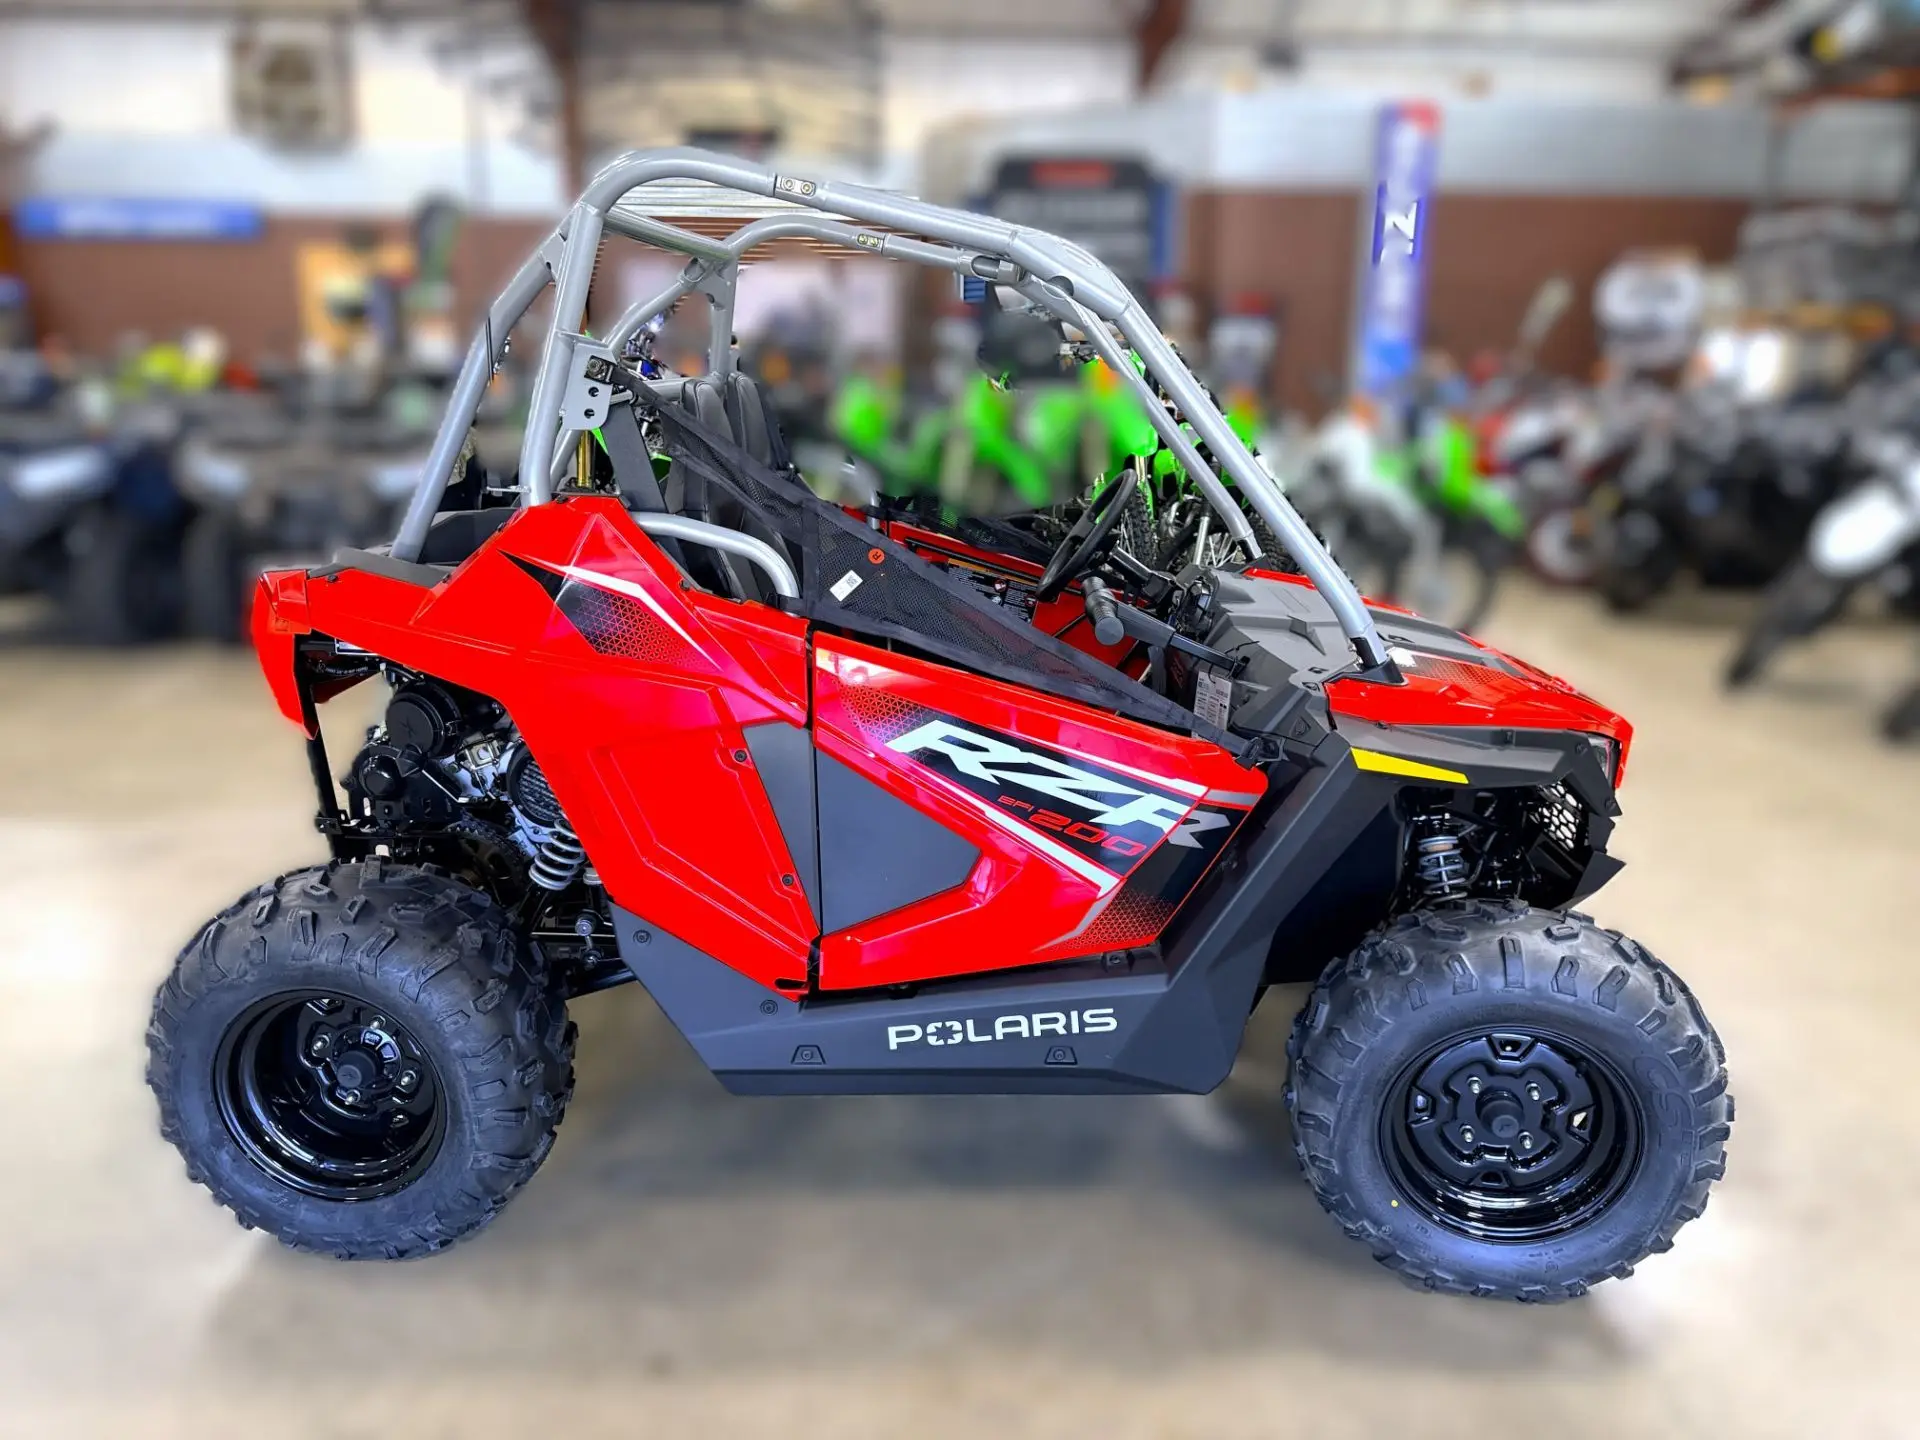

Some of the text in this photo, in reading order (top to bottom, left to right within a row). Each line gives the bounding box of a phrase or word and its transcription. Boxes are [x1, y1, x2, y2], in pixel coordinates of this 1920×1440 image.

[885, 720, 1231, 849] RZR
[998, 795, 1147, 856] EFI 200
[887, 1008, 1118, 1050] POLARIS
